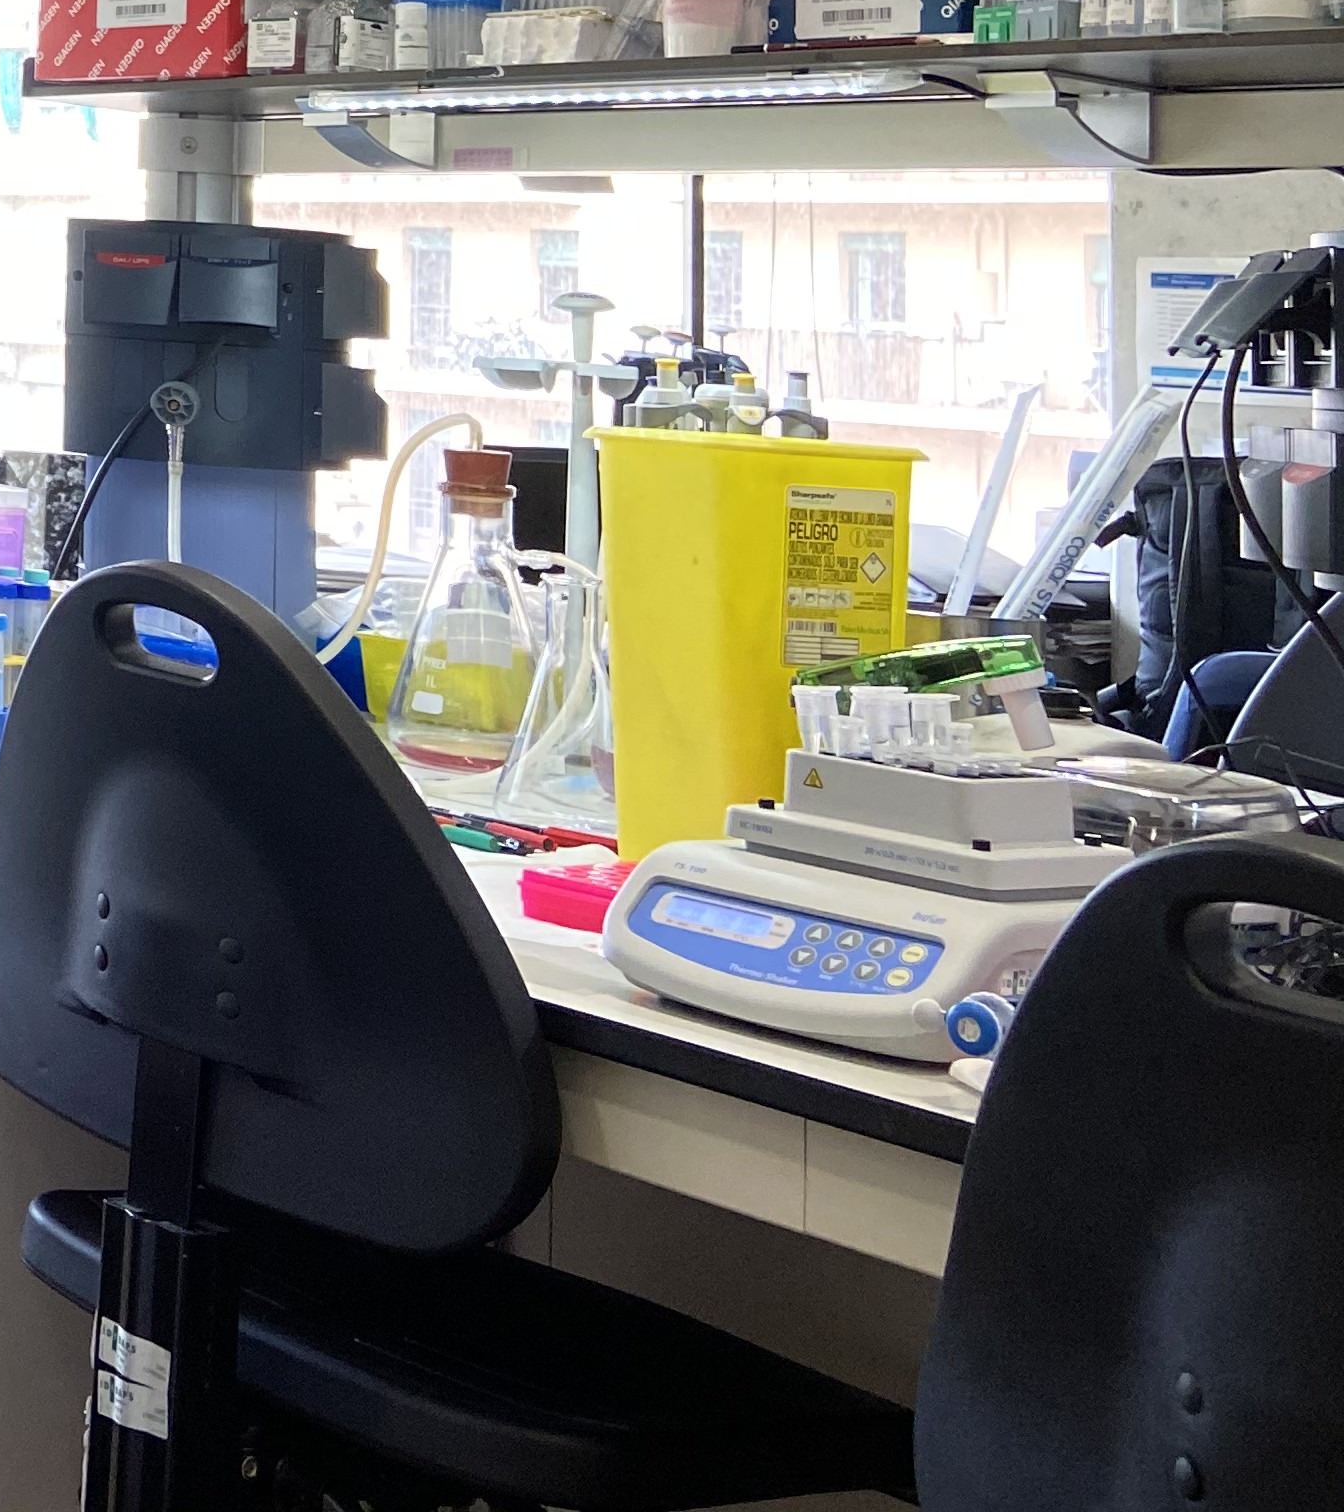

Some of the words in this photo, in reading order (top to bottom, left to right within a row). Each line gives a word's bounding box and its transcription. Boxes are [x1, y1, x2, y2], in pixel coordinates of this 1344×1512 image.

[54, 30, 83, 67] QIAGEN
[115, 38, 145, 76] QIAGEN
[792, 490, 835, 500] Sharpsafe
[789, 521, 838, 541] PELIGRO
